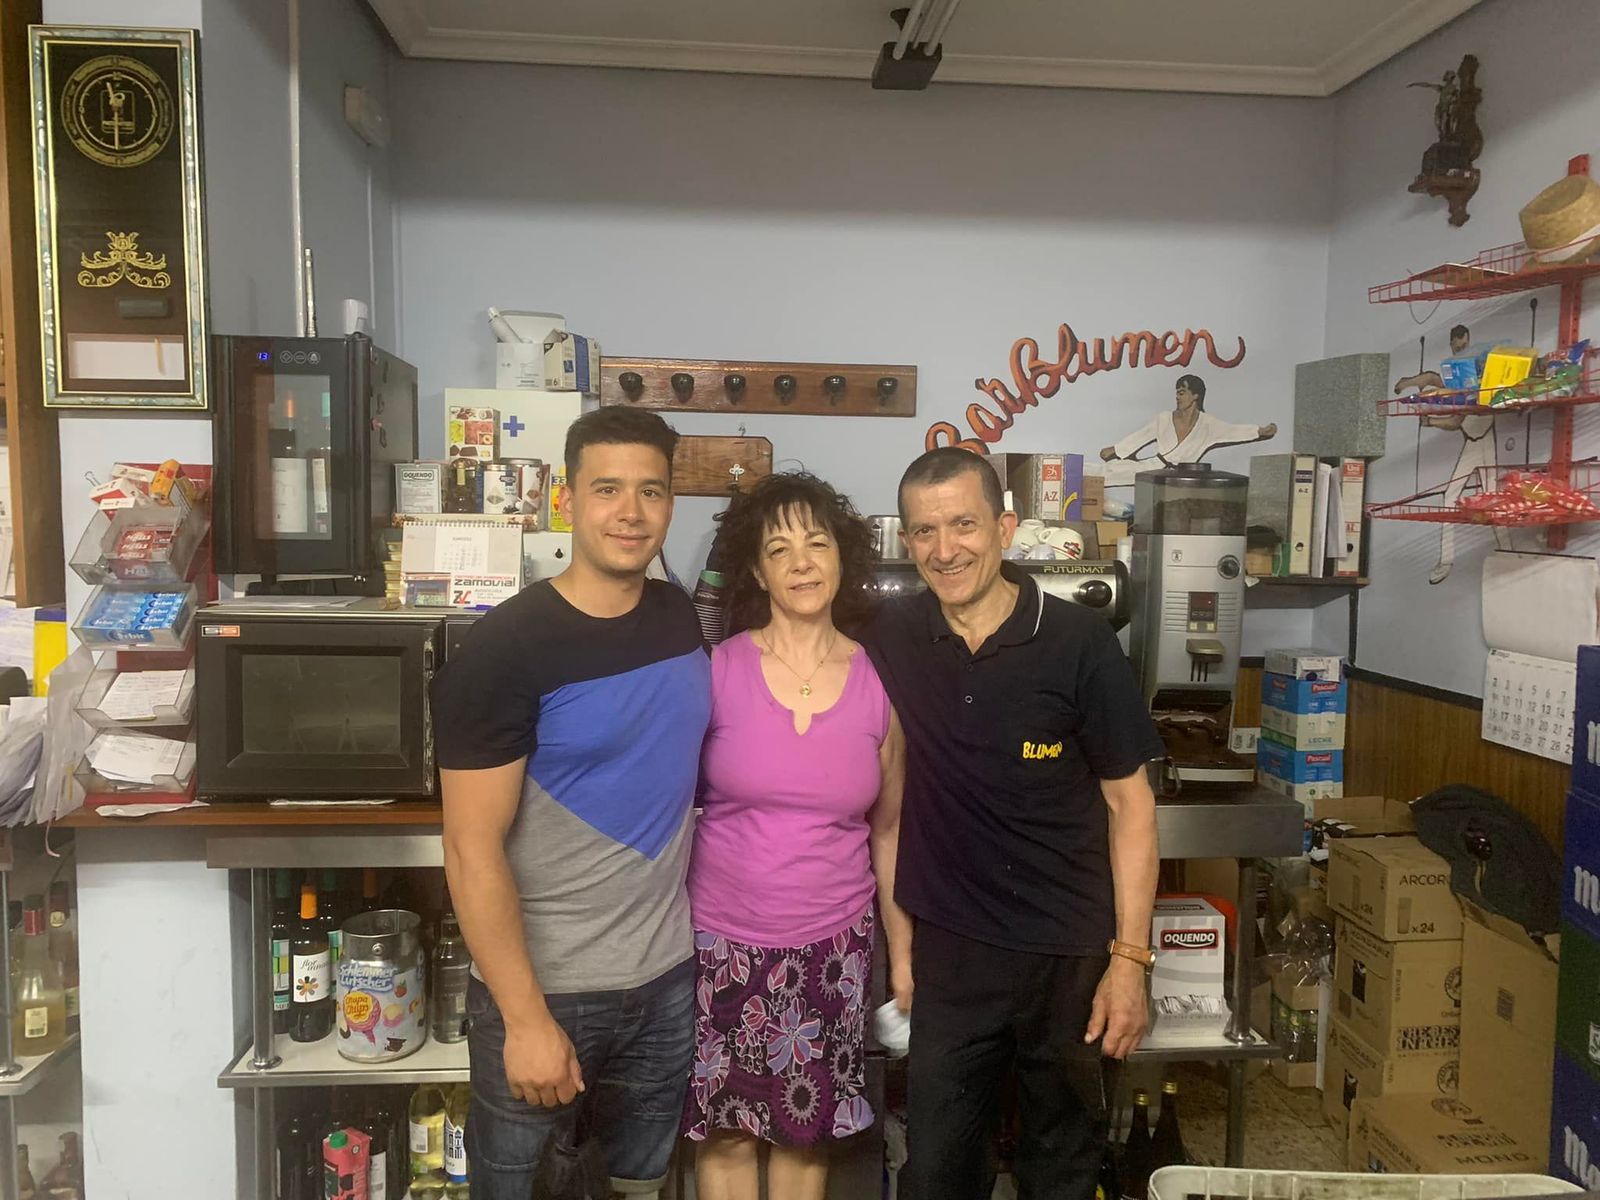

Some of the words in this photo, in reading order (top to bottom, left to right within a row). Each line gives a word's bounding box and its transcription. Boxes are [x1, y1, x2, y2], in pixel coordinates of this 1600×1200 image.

[1010, 323, 1246, 406] Blumen
[403, 472, 433, 480] OQUENDO
[1043, 491, 1058, 502] A-Z
[1044, 566, 1105, 574] FUTURMAT
[454, 577, 516, 587] zamovial
[1164, 933, 1215, 946] OQUENDO
